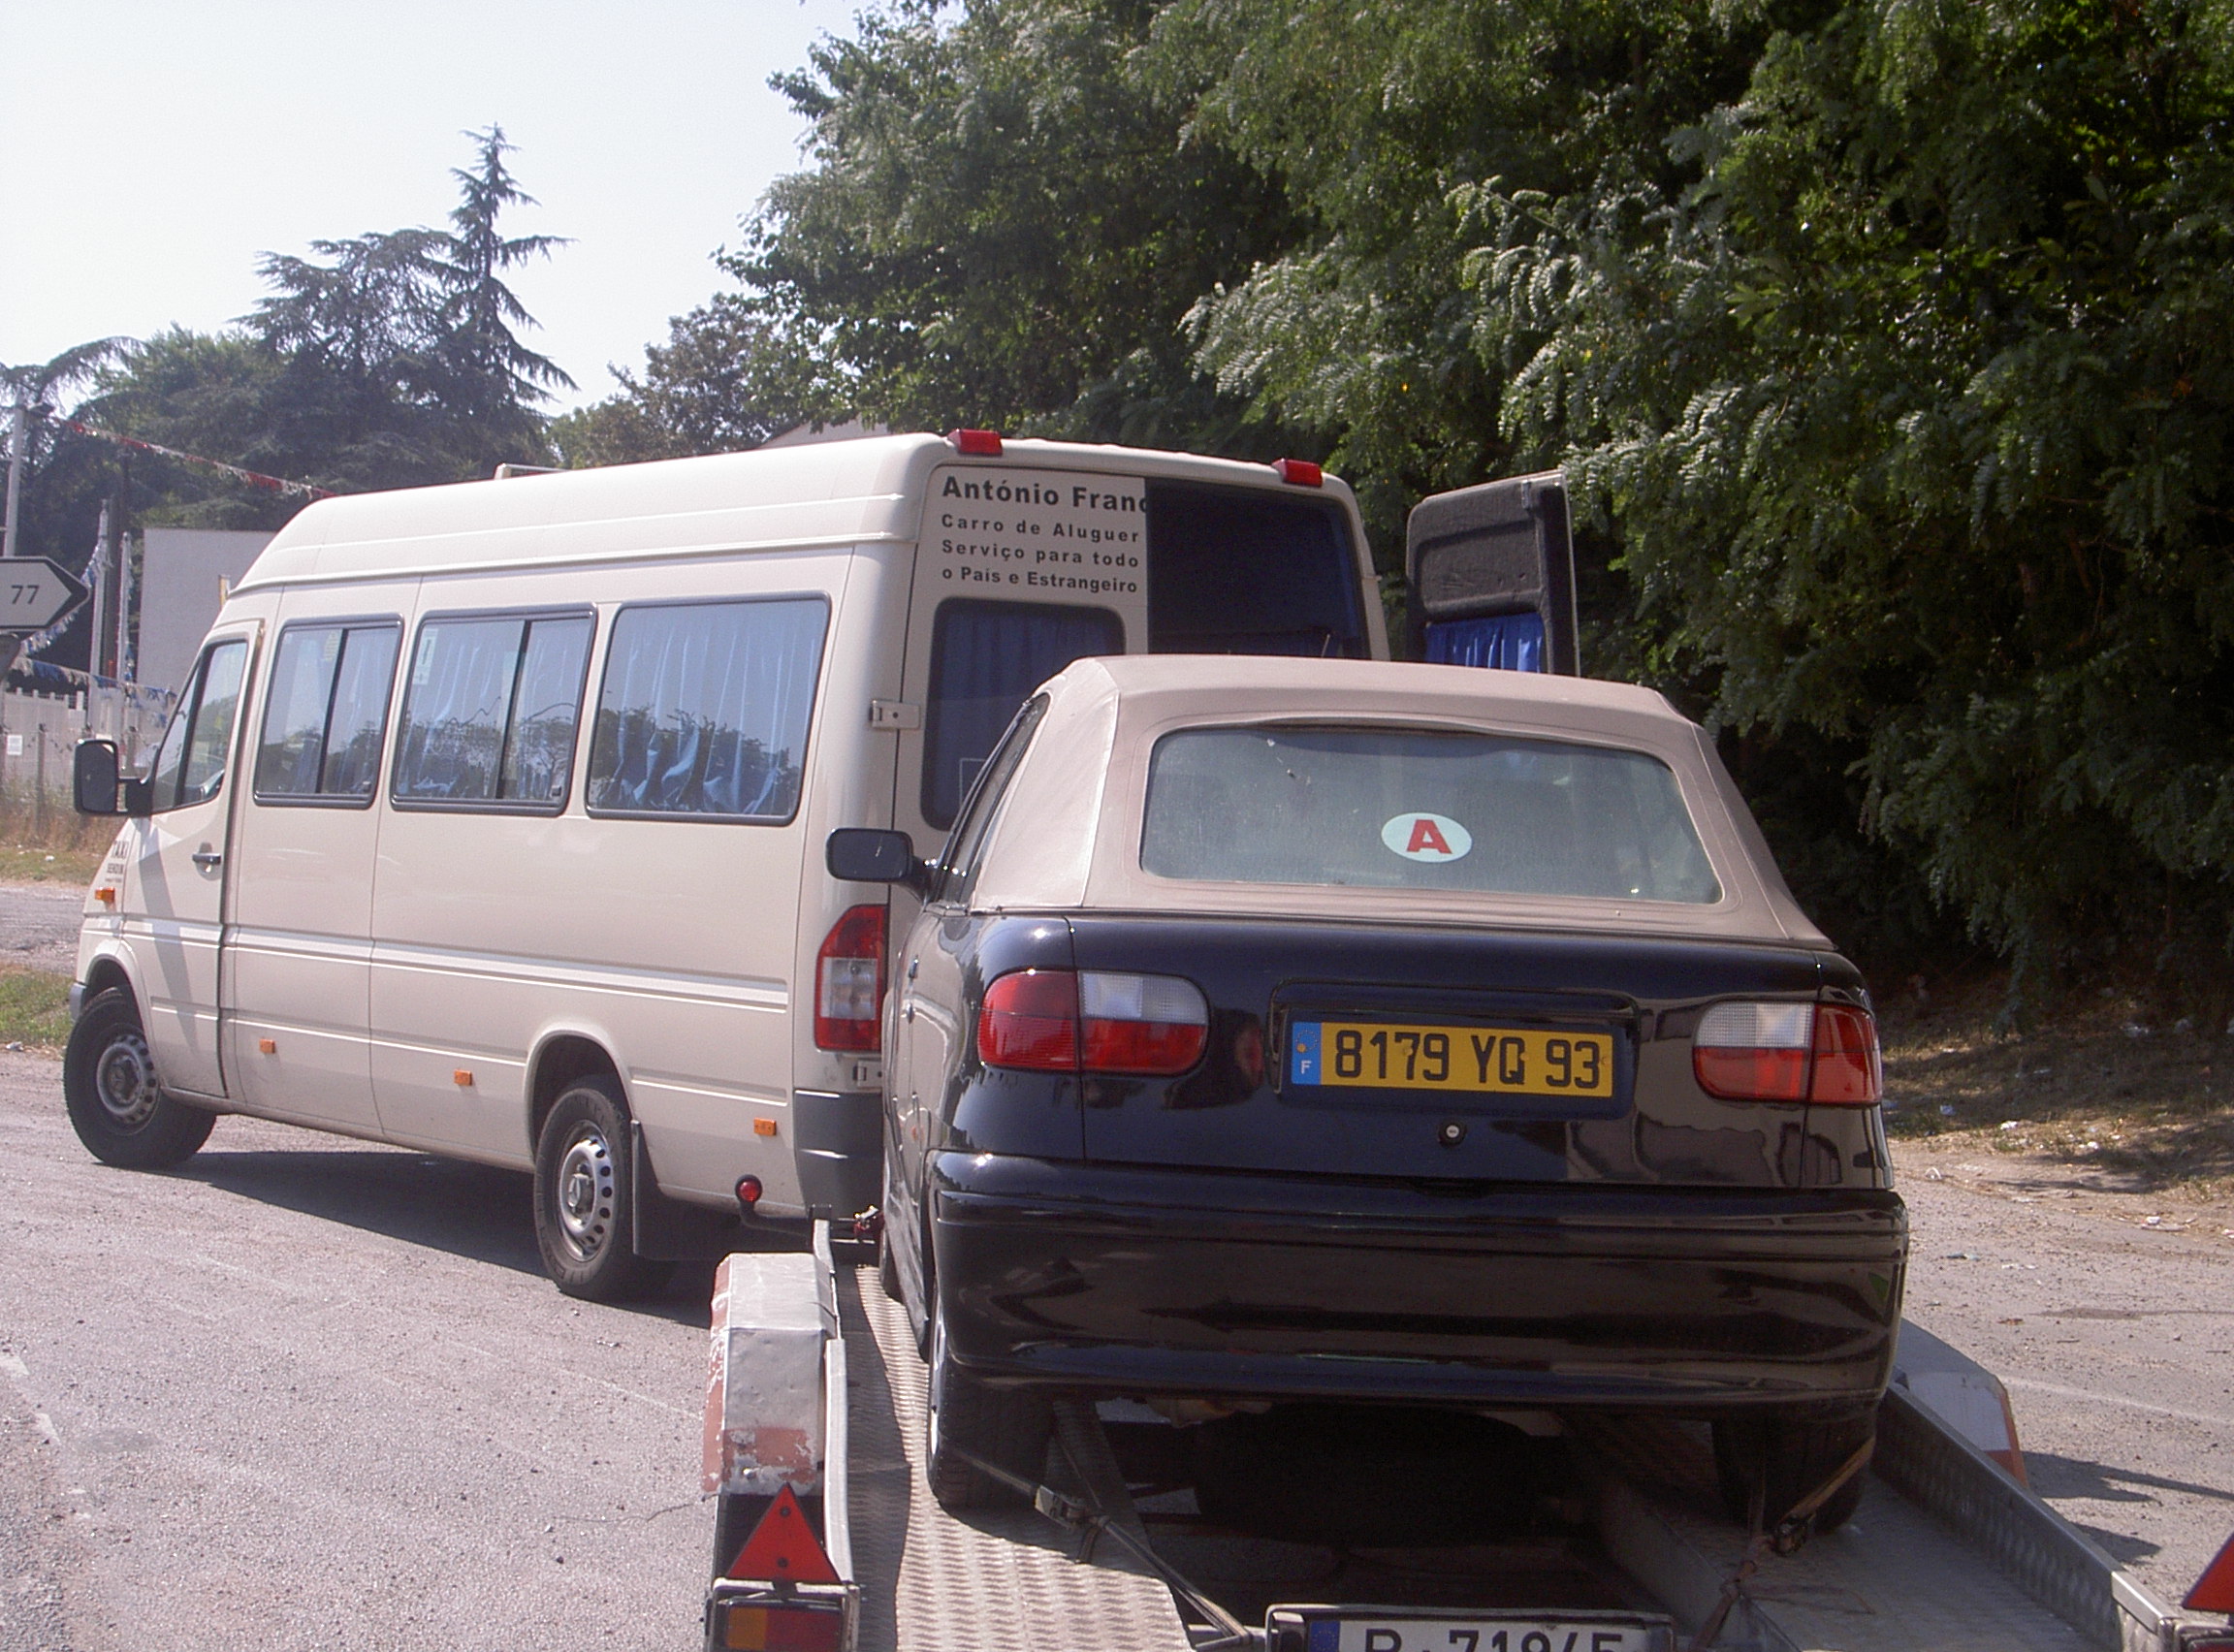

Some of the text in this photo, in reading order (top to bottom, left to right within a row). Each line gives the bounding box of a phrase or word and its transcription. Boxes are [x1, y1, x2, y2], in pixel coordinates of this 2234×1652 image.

[941, 475, 1060, 506] António
[941, 513, 1139, 543] Carro de Aluguer
[941, 539, 1139, 567] Serviço para todo
[10, 585, 40, 605] 77
[942, 568, 953, 580] o
[1008, 573, 1020, 585] e
[1027, 571, 1137, 594] Estrangeiro
[1406, 819, 1452, 854] A
[1300, 1060, 1312, 1075] F
[1335, 1030, 1600, 1090] 8179 YQ 93
